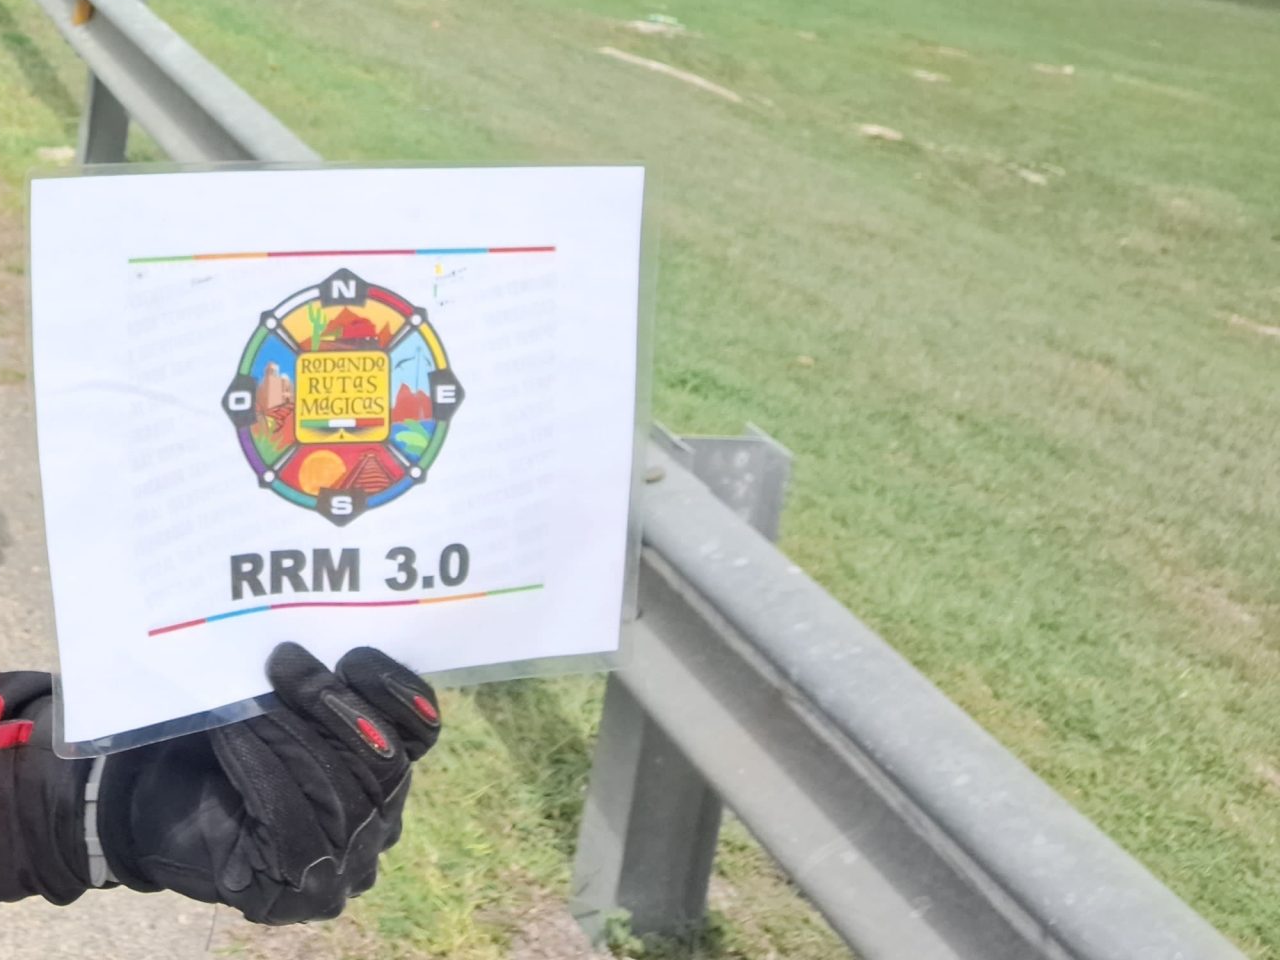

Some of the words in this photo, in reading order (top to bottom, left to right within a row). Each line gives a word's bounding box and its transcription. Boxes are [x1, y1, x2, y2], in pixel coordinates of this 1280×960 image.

[331, 279, 357, 299] N
[228, 391, 252, 411] O
[435, 385, 457, 404] E
[330, 496, 353, 515] S
[230, 547, 361, 601] RRM
[384, 542, 470, 591] 3.0
